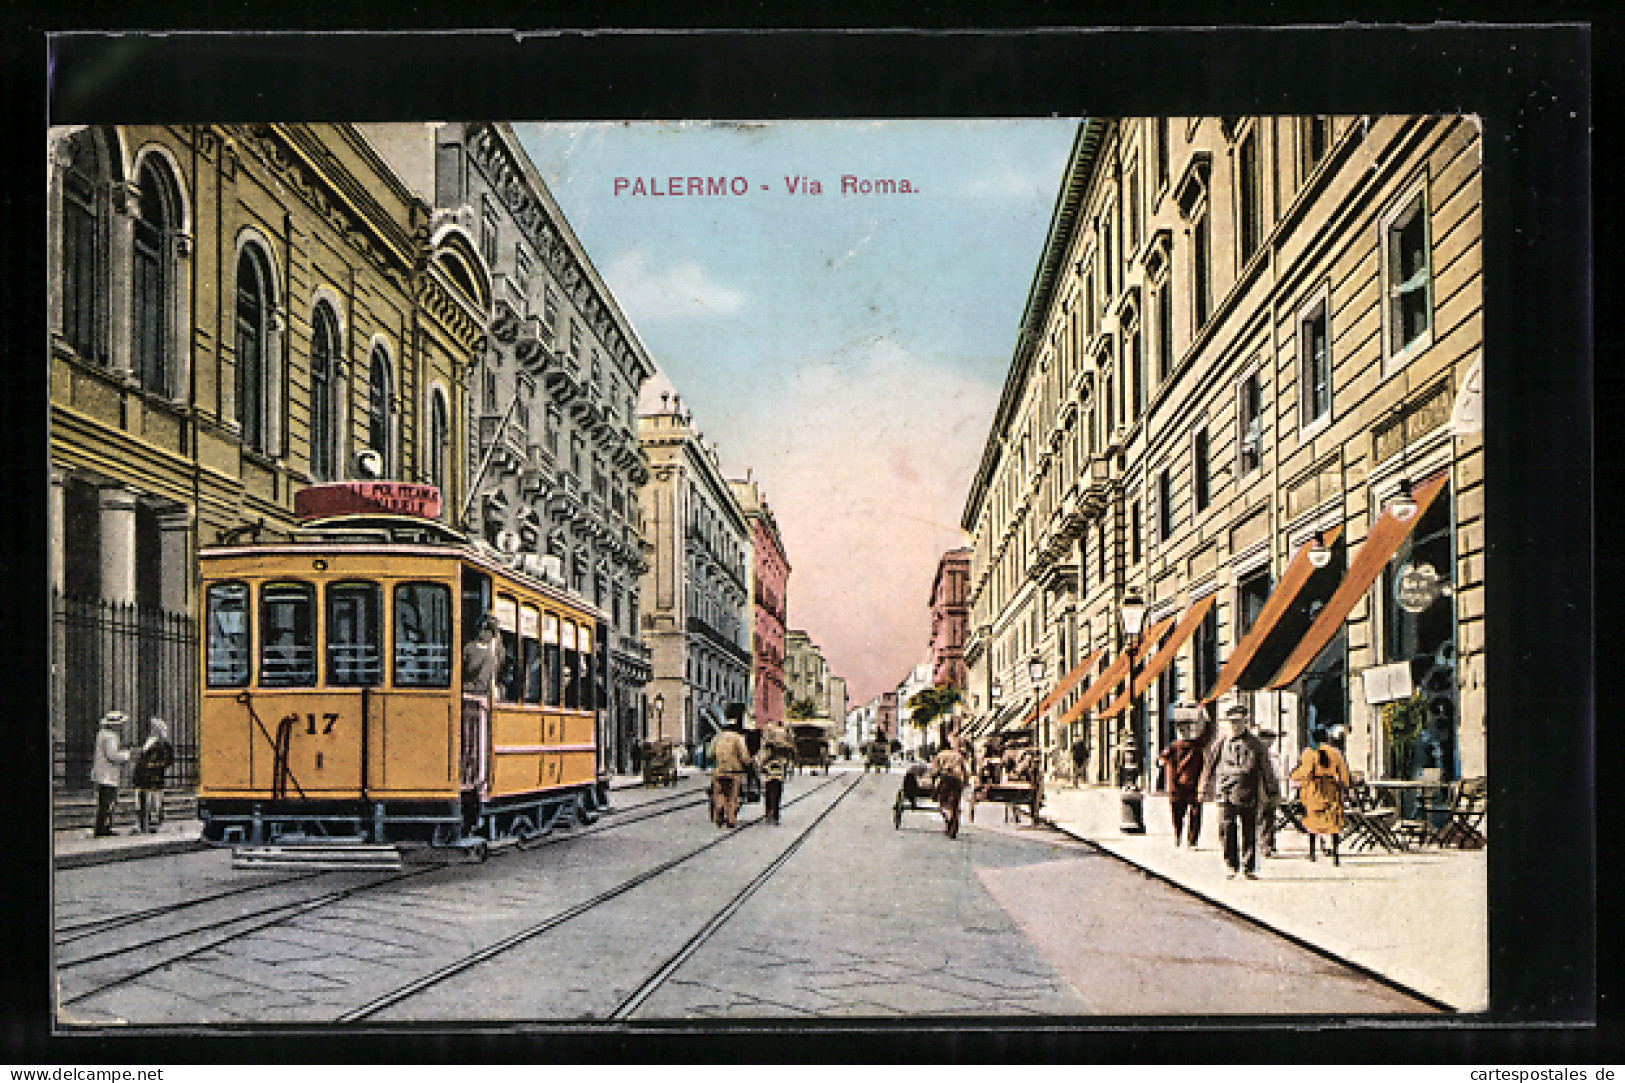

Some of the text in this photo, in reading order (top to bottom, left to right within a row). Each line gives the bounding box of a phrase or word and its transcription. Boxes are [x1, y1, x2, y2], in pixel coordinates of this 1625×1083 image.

[613, 176, 749, 196] PALERMO
[783, 175, 823, 195] Via
[840, 174, 920, 195] Roma.
[304, 713, 339, 735] 17
